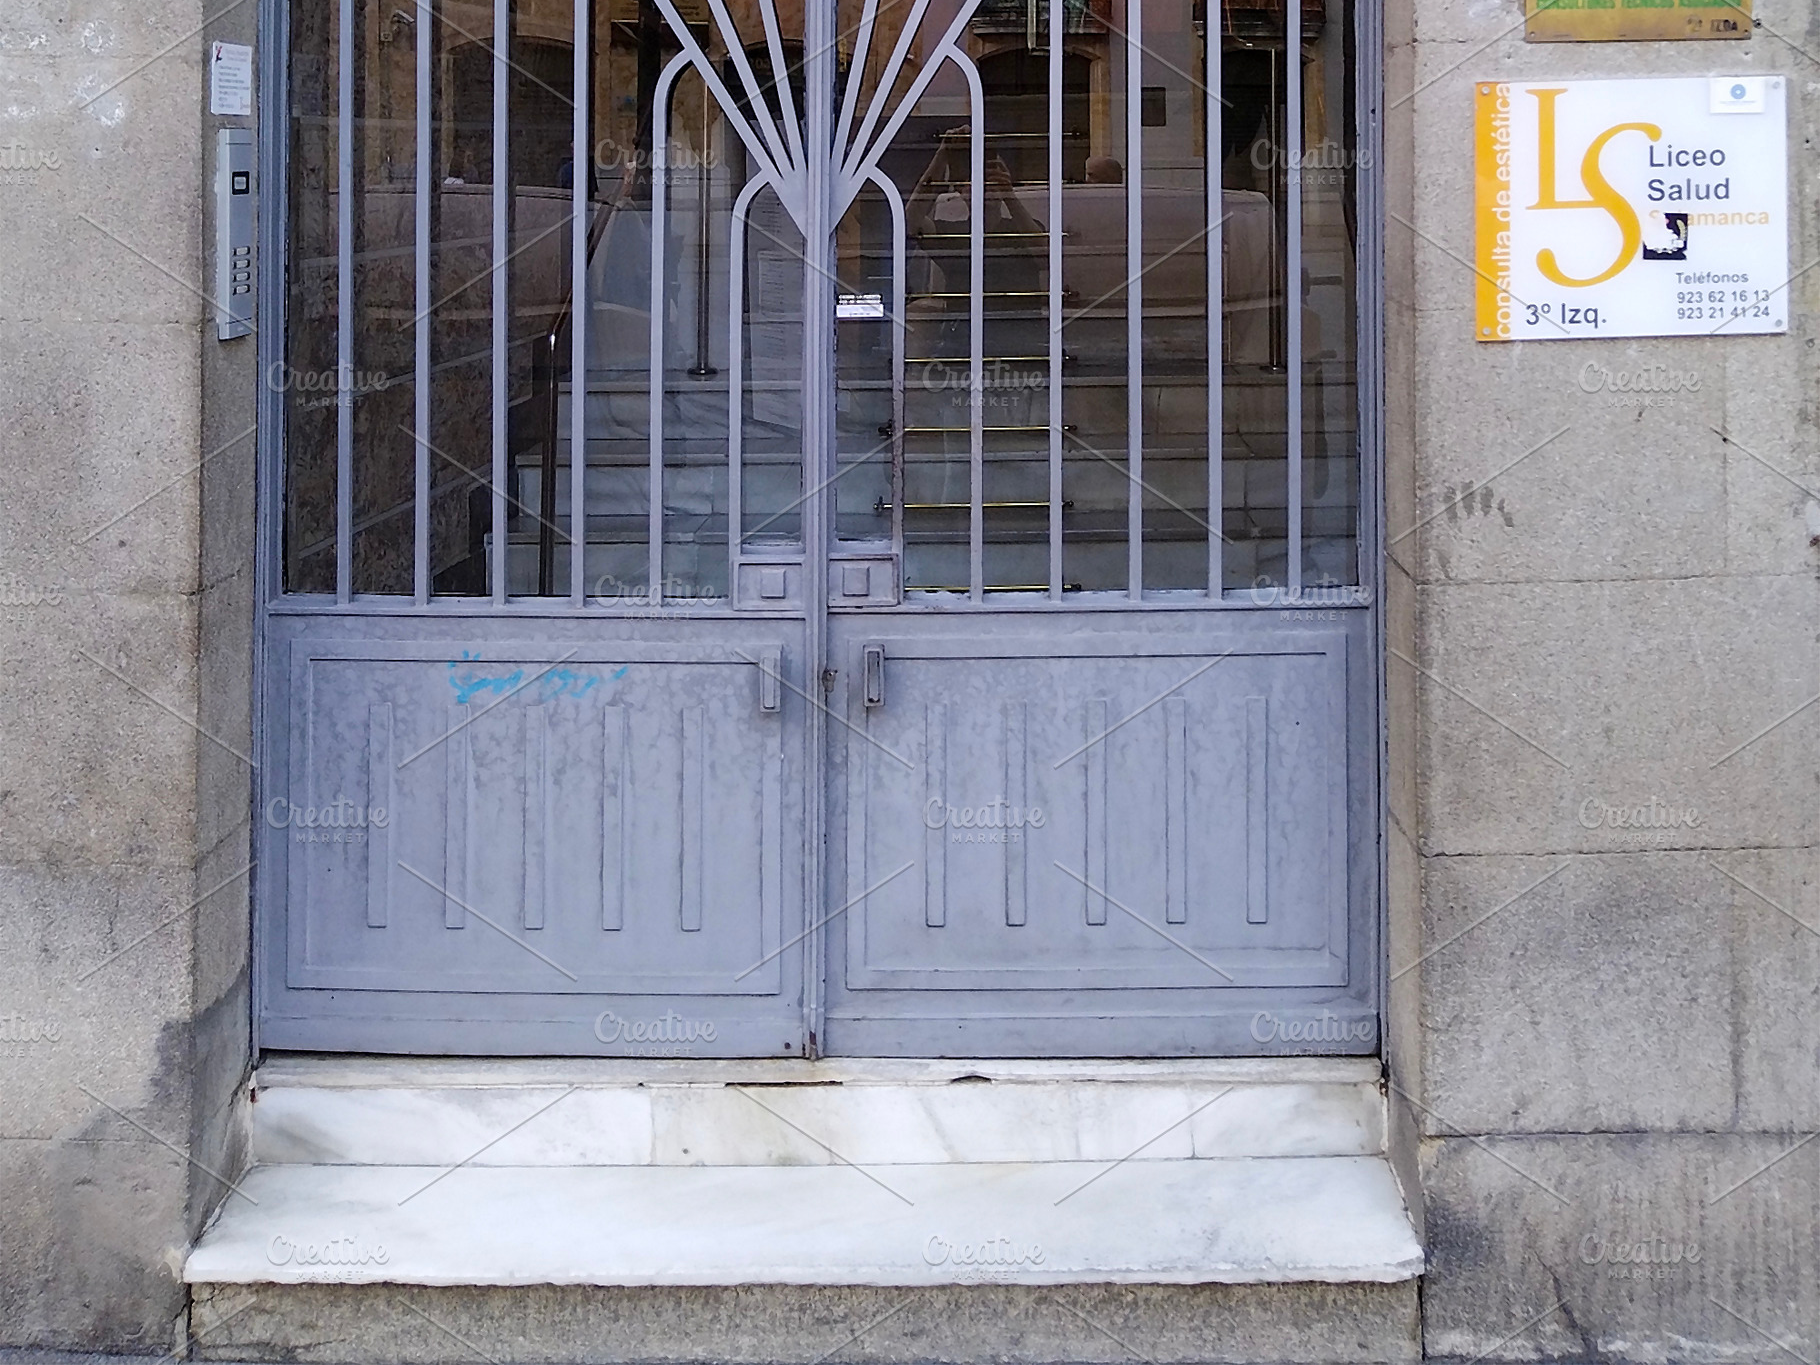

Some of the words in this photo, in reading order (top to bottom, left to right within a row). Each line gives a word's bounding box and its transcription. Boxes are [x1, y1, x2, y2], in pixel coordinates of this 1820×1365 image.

[1490, 82, 1511, 183] estética
[1649, 144, 1727, 168] Liceo
[1647, 178, 1730, 202] Salud
[1491, 190, 1511, 223] de
[1491, 232, 1511, 339] consulta
[1676, 272, 1750, 285] Teléfonos
[1677, 291, 1704, 304] 923
[1708, 291, 1726, 303] 62
[1732, 290, 1748, 302] 16
[1753, 290, 1770, 302] 13
[1525, 303, 1552, 326] 3º
[1561, 303, 1607, 328] Izq.
[1677, 307, 1704, 320] 923
[1709, 307, 1725, 319] 21
[1730, 306, 1747, 318] 41
[1752, 306, 1770, 318] 24
